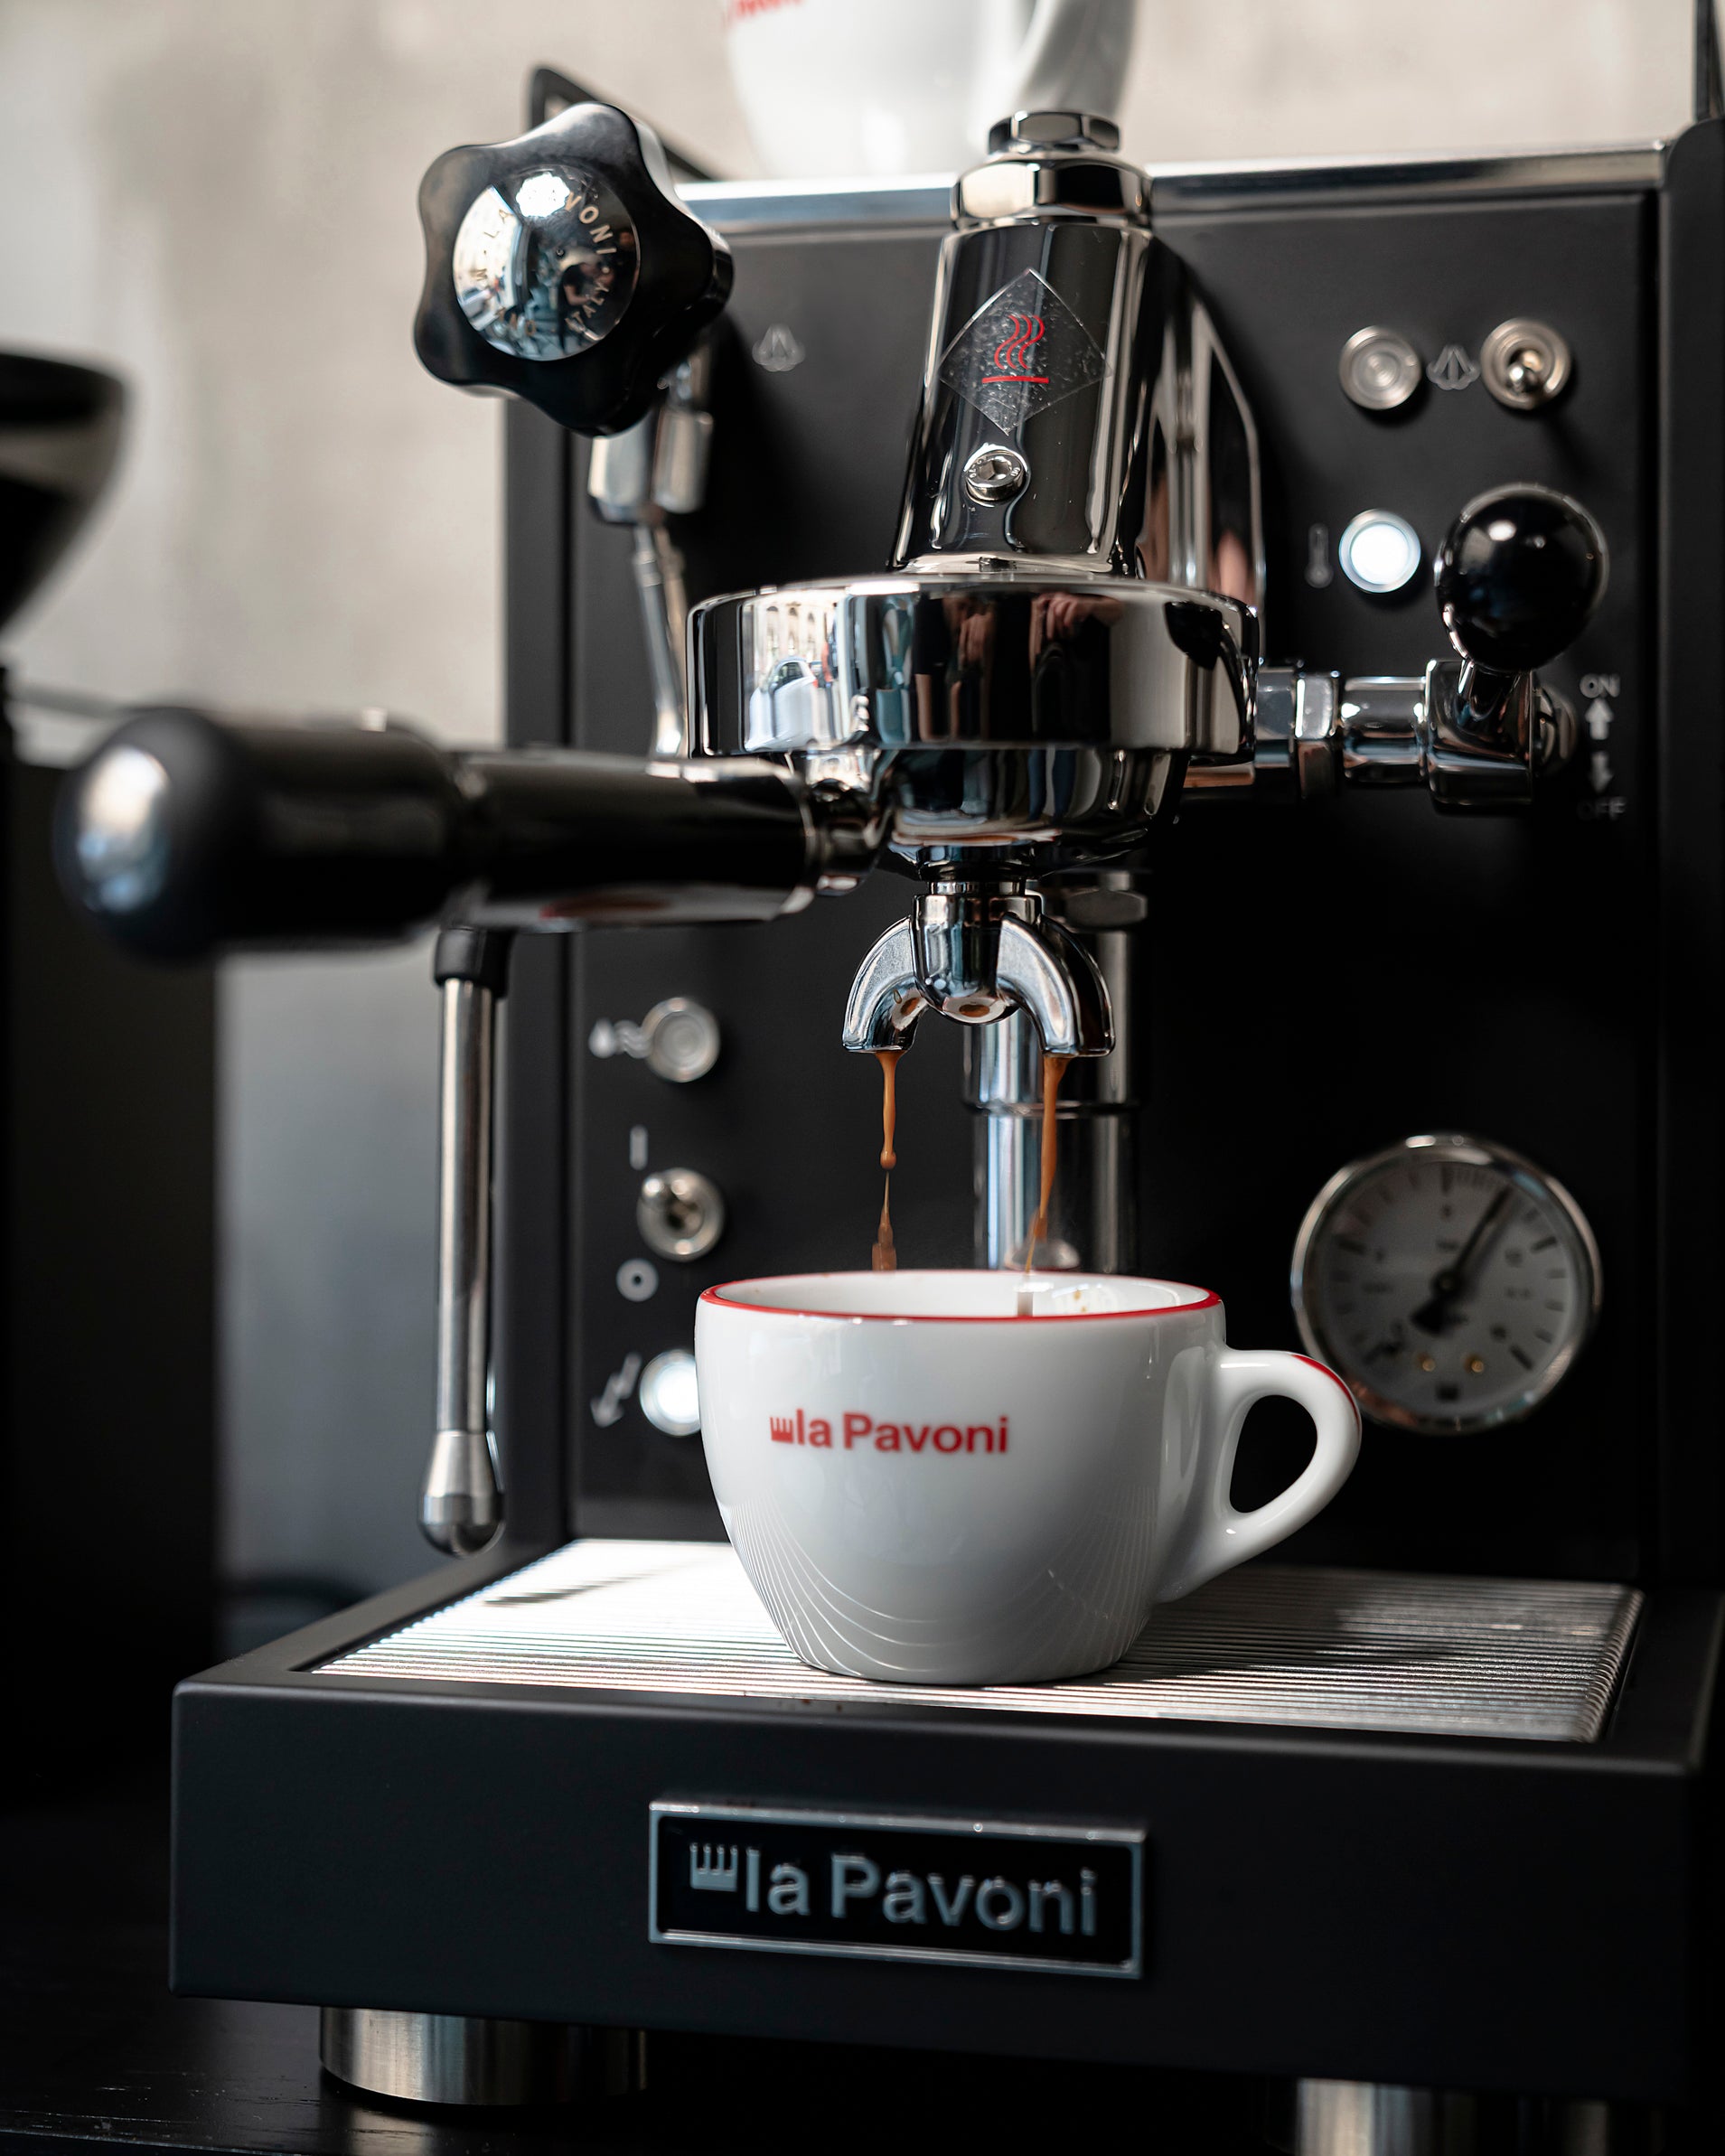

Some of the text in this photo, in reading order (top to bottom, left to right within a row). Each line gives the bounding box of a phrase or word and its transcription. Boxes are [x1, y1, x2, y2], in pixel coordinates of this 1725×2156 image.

[1580, 673, 1621, 698] ON
[795, 1407, 1009, 1455] la Pavoni
[745, 1846, 1098, 1936] la Pavoni
